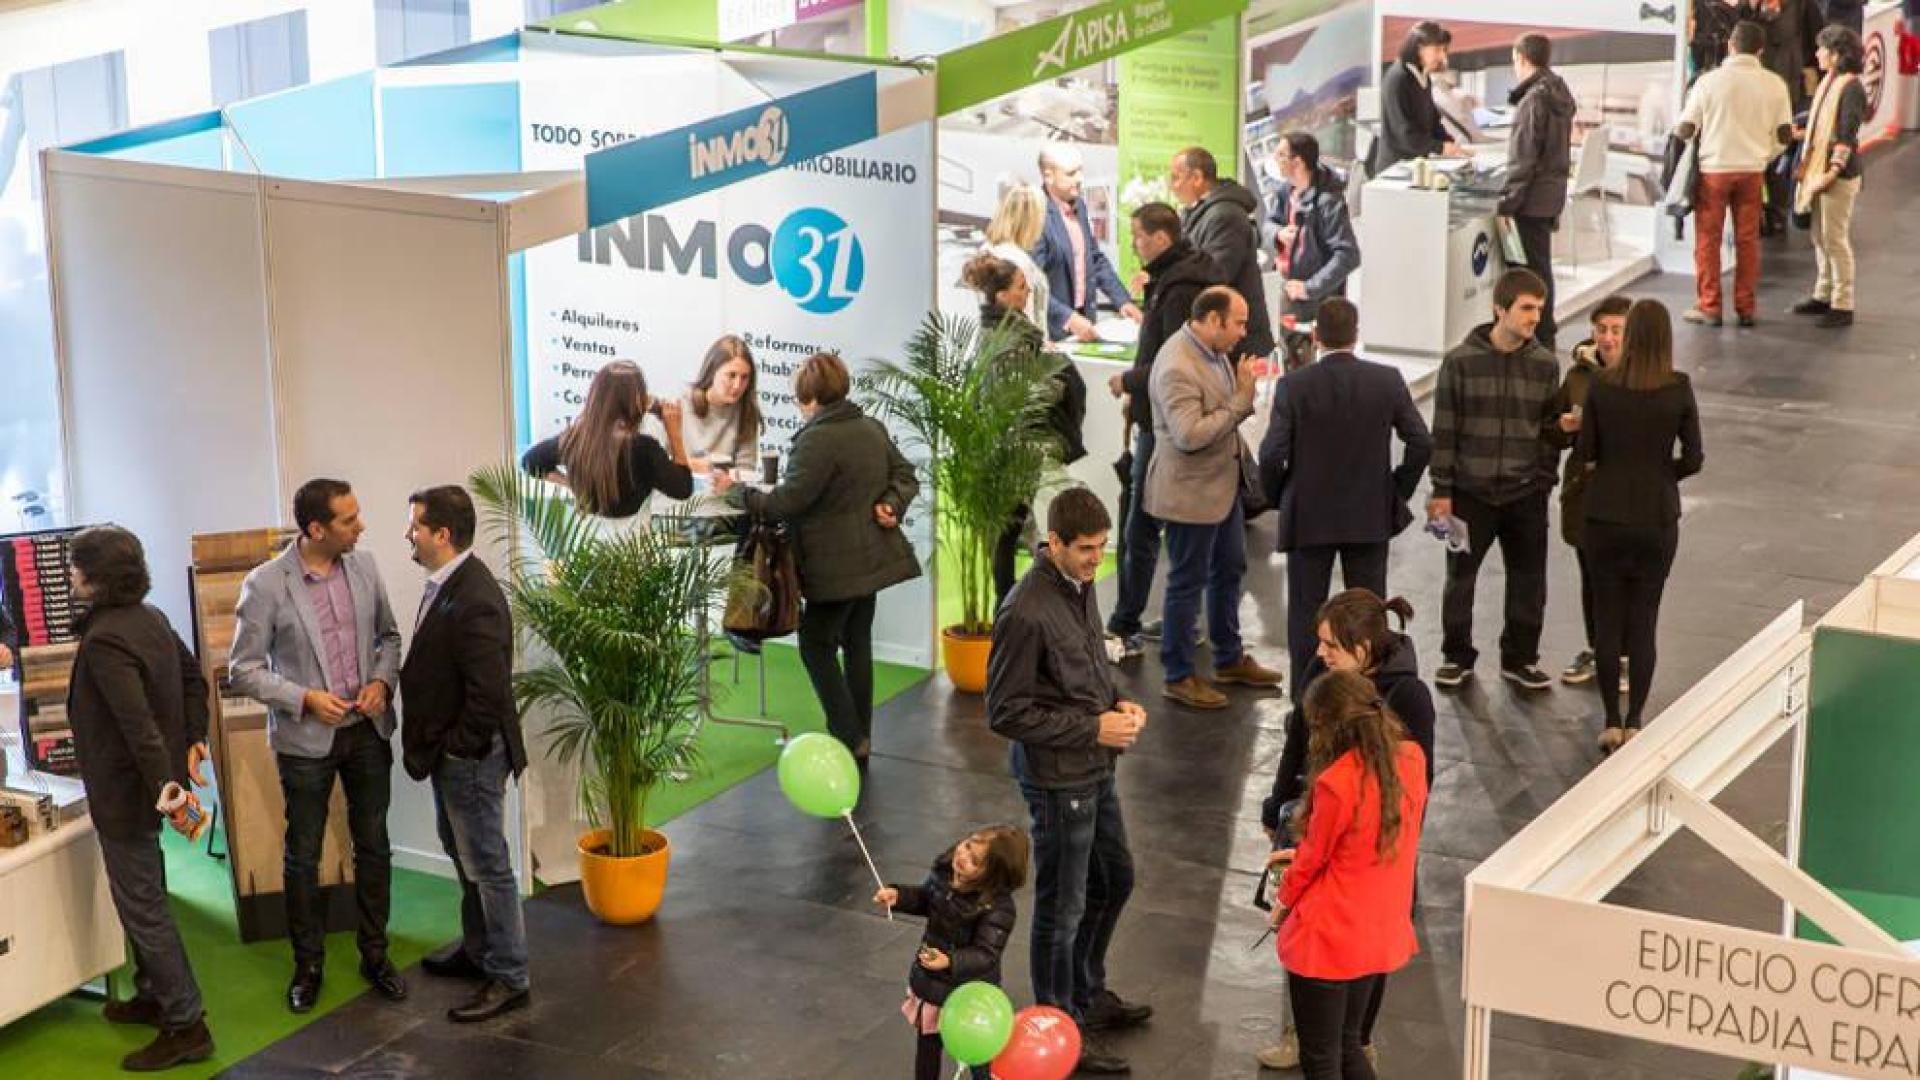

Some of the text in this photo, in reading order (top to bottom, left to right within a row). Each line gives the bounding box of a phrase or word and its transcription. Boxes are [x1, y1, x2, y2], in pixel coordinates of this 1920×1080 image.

[1074, 9, 1129, 59] APISA
[531, 123, 582, 146] TODO
[562, 309, 640, 332] Alquileres
[562, 335, 616, 355] Ventas
[1640, 930, 1920, 1019] EDIFICIO COFR
[1606, 980, 1814, 1055] COFRADIA
